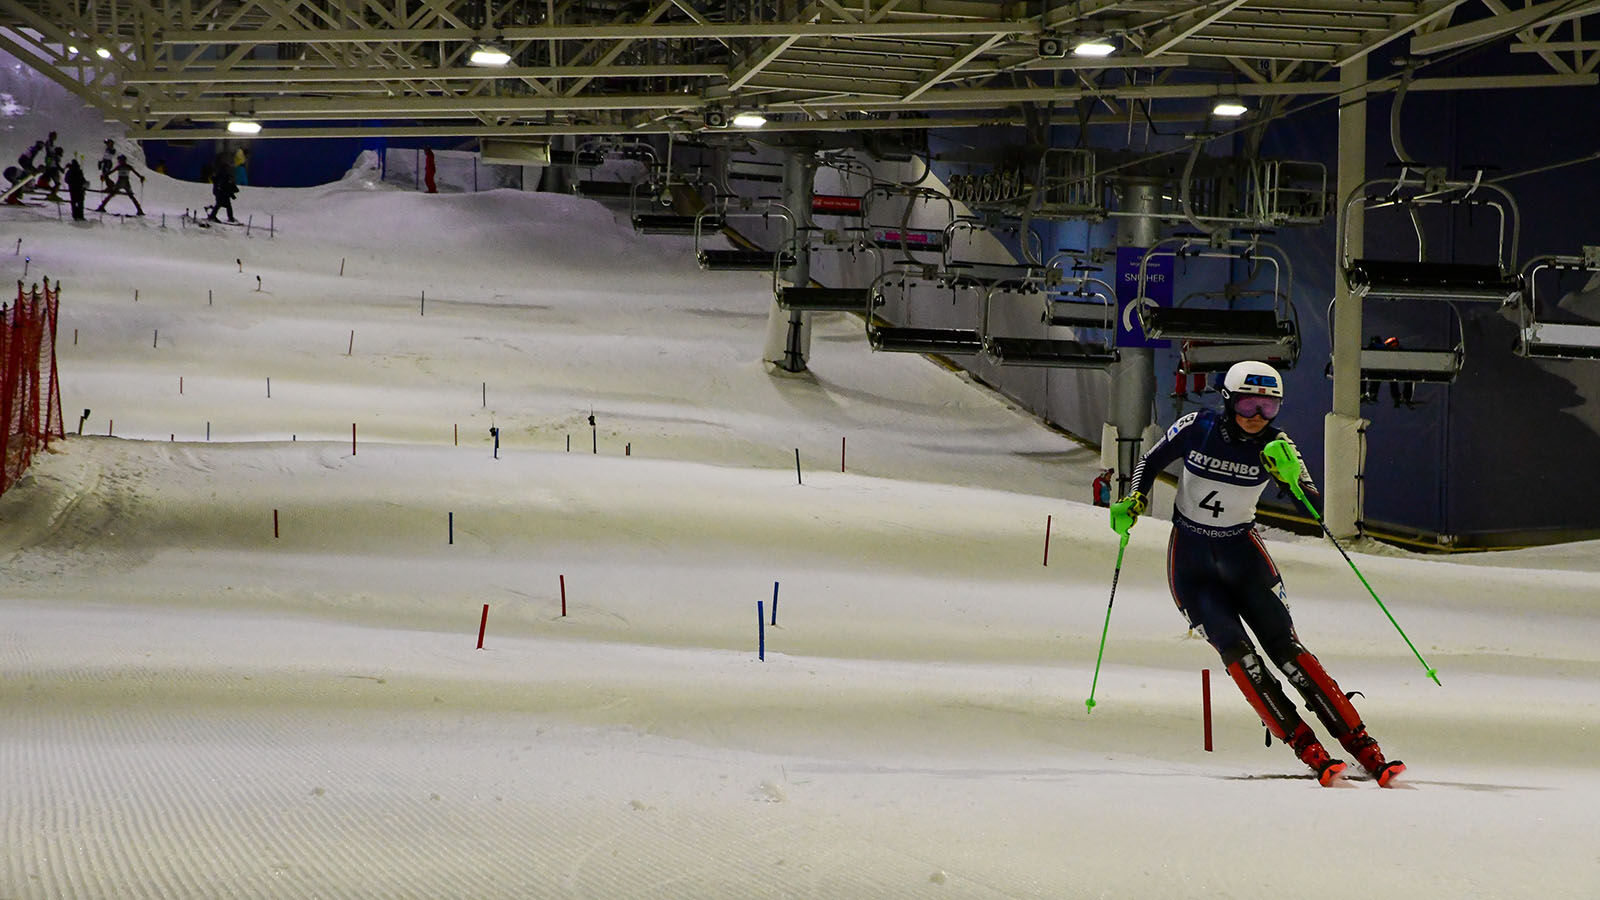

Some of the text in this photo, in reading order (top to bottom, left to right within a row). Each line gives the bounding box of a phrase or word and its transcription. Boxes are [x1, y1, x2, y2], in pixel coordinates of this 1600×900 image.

[1260, 60, 1270, 70] 10
[1146, 274, 1165, 282] HER
[1189, 450, 1260, 476] FRYDENBØ
[1199, 490, 1225, 519] 4
